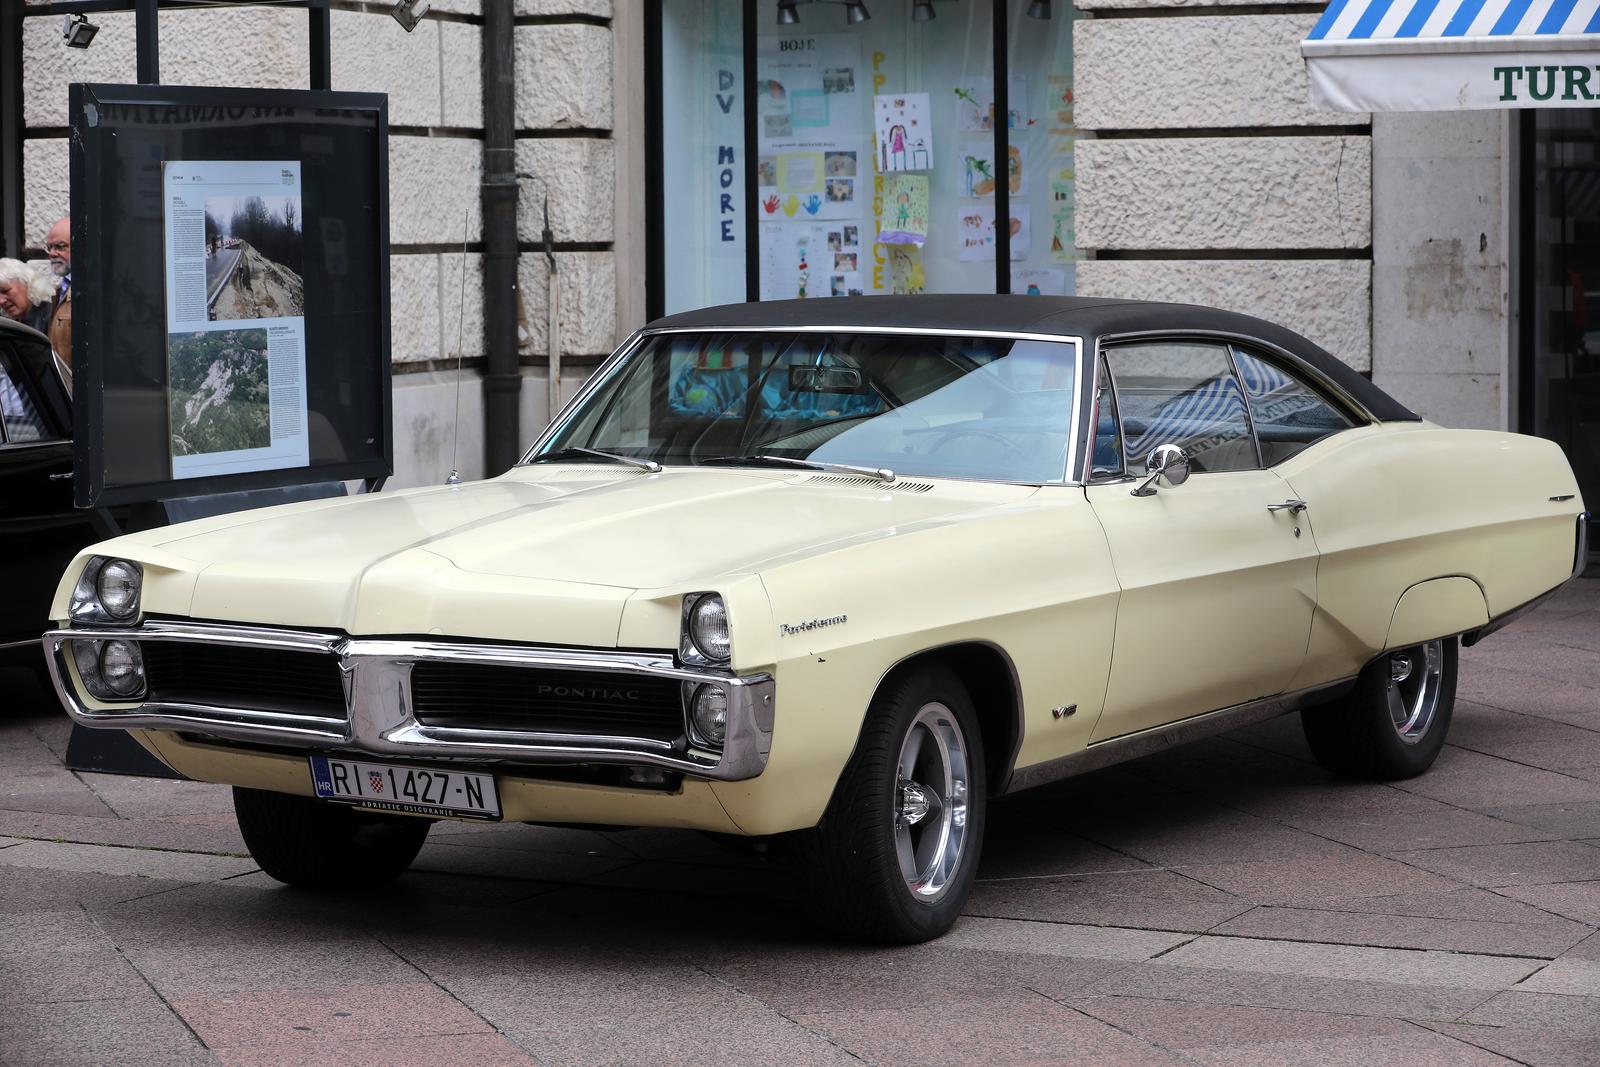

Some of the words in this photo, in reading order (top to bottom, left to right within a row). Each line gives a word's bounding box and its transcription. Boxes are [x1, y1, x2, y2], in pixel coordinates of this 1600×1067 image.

[779, 38, 815, 52] BOJE
[716, 69, 735, 114] DV
[717, 145, 736, 242] MORE
[537, 684, 640, 700] PONTIAC
[318, 780, 333, 792] HR
[331, 762, 362, 796] RI
[388, 767, 484, 809] 1427-N
[362, 800, 401, 812] ADRIATIC
[404, 805, 454, 817] OSIGURANJE
